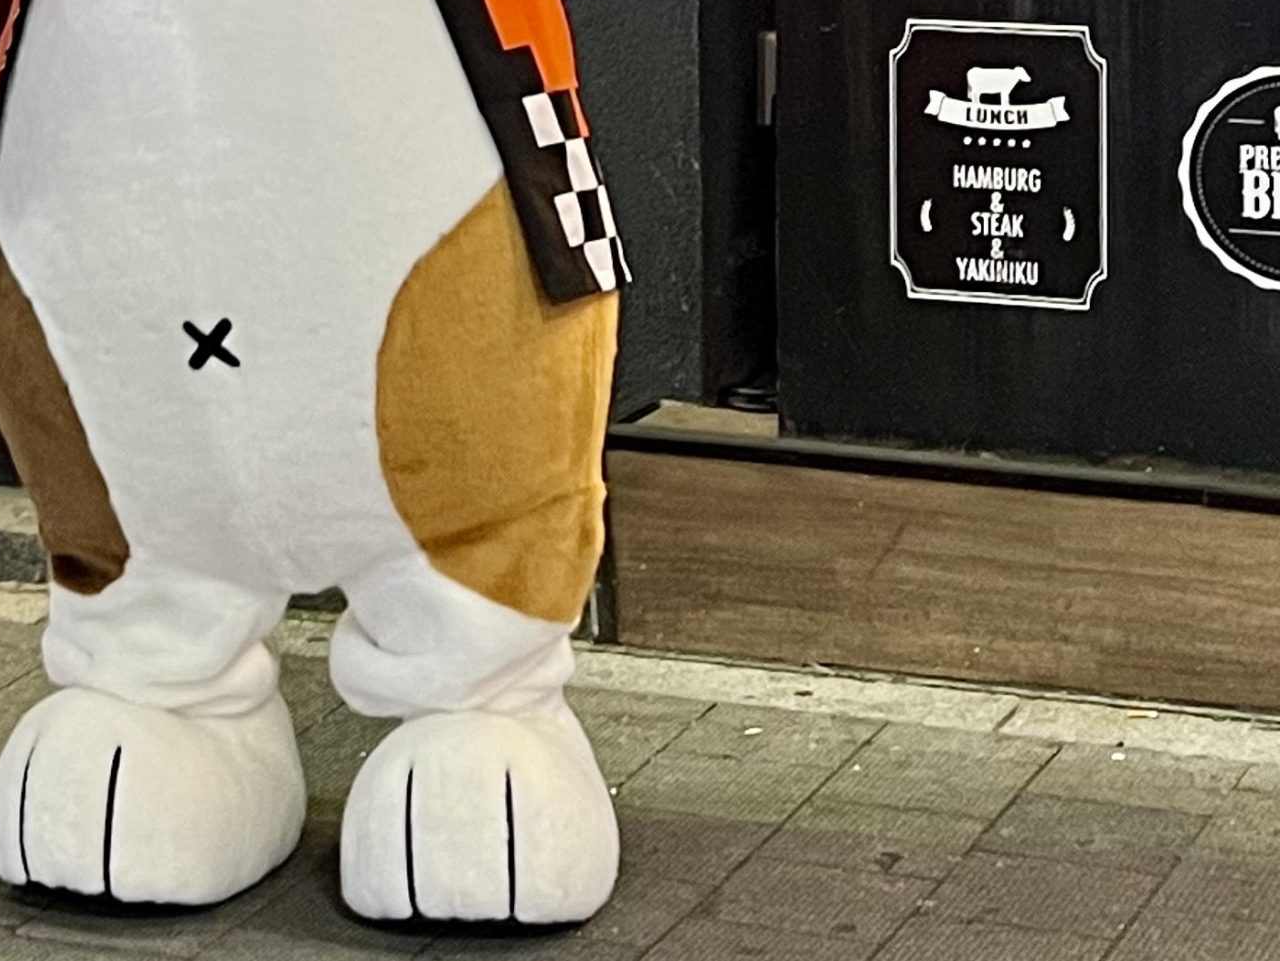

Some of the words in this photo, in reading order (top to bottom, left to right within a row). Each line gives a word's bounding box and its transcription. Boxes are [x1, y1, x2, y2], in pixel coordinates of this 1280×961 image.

[965, 106, 1030, 126] LUNCH
[953, 164, 1042, 193] HAMBURG
[989, 192, 1005, 213] &
[970, 211, 1025, 238] STEAK
[990, 238, 1005, 259] &
[955, 256, 1040, 286] YAKINIKU
